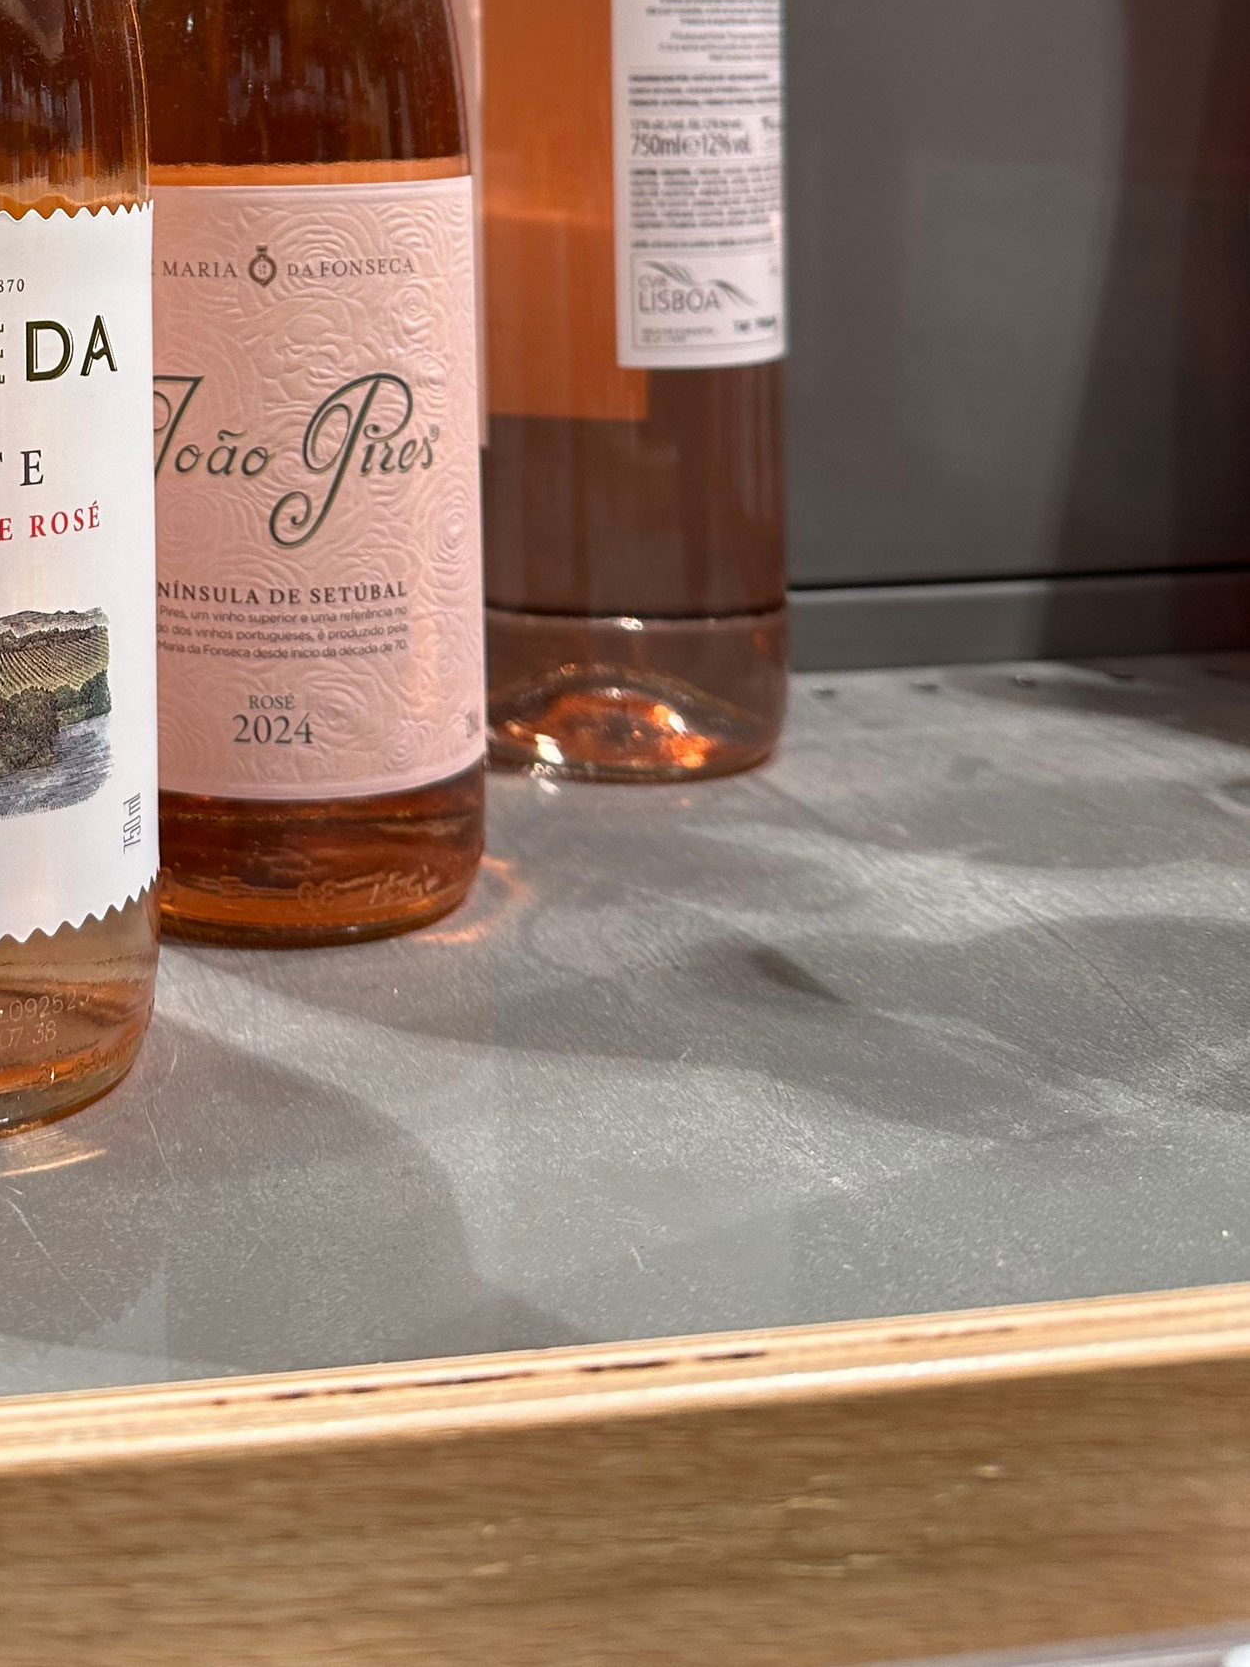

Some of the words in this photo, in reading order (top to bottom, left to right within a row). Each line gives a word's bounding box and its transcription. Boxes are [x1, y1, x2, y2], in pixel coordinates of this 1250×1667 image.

[162, 260, 238, 278] MARIA
[287, 263, 313, 277] DA
[319, 257, 416, 278] FONSECA
[29, 500, 102, 539] ROSÉ
[156, 579, 260, 605] NÍNSULA
[269, 588, 301, 605] DE
[309, 580, 408, 604] SETÚBAL
[248, 693, 296, 710] ROSÉ
[231, 711, 314, 745] 2024
